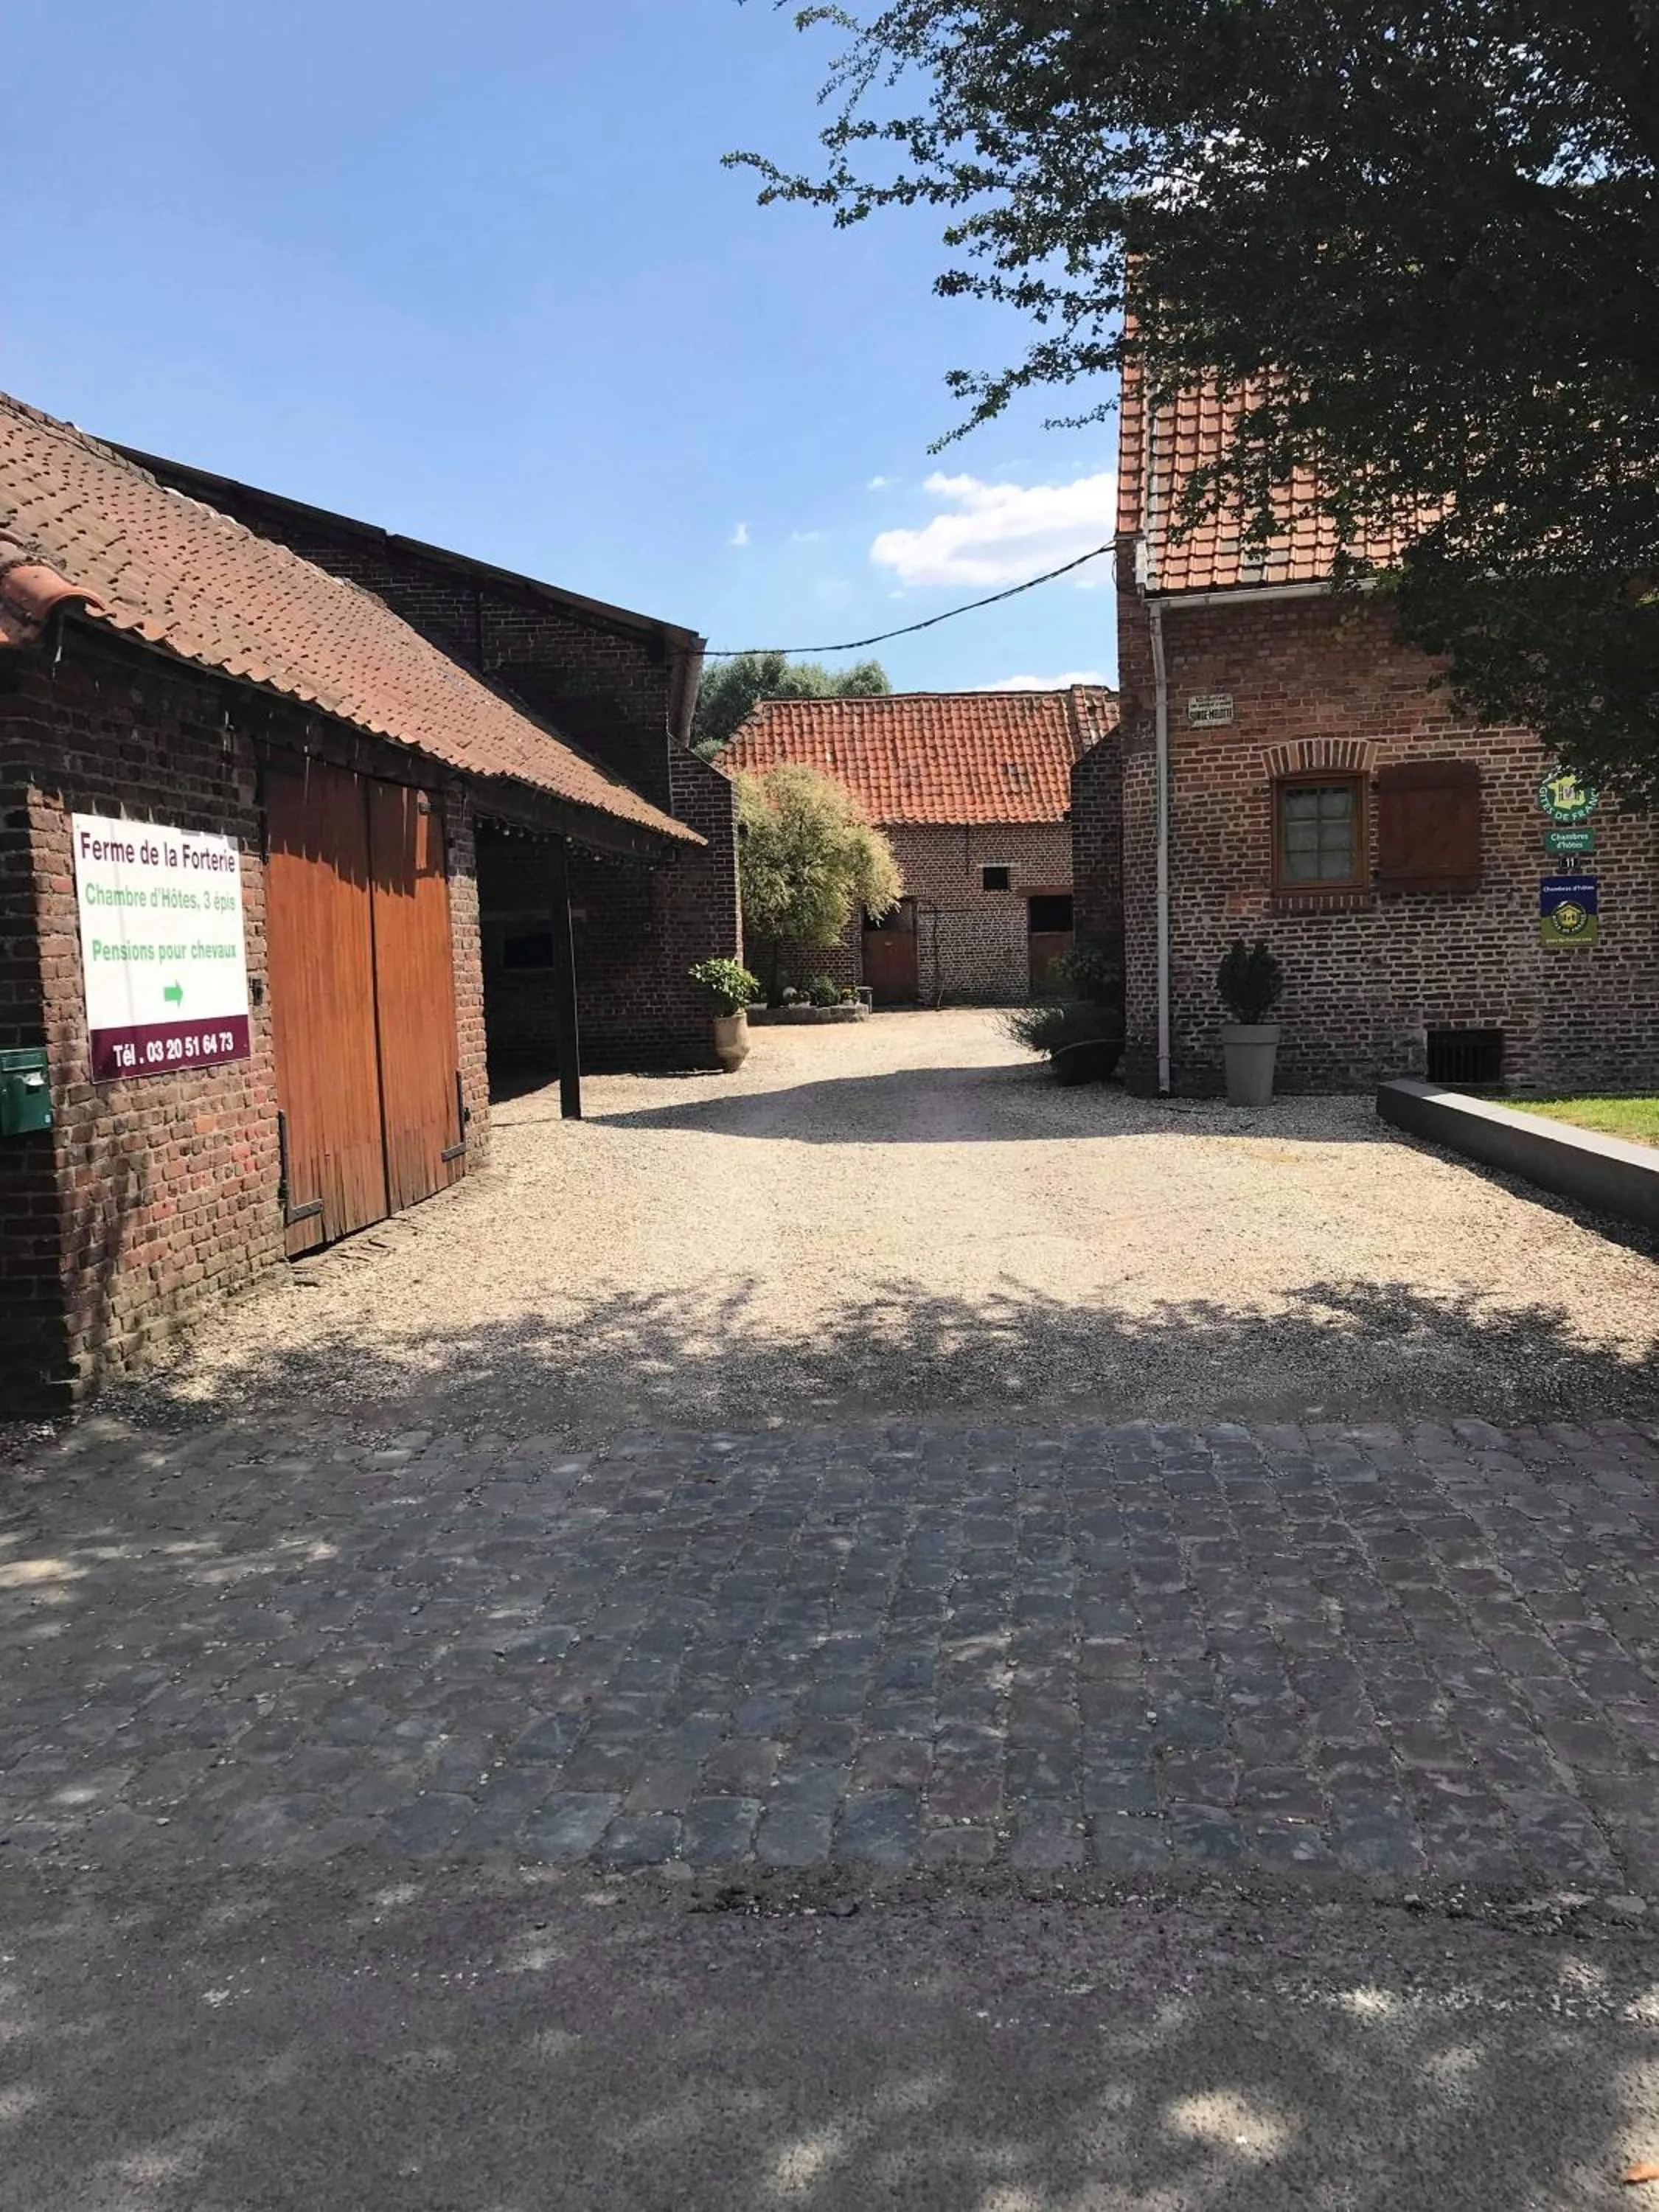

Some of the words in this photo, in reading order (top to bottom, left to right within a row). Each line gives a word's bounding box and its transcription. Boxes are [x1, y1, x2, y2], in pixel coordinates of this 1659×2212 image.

[1571, 787, 1599, 821] FRANC
[80, 832, 135, 863] Ferme
[140, 839, 159, 866] de
[164, 841, 178, 868] la
[182, 844, 235, 873] Forterie
[1565, 858, 1574, 868] 11
[85, 883, 147, 906] Chambre
[150, 887, 201, 912] d'Hôtes,
[204, 891, 211, 910] 3
[214, 891, 236, 914] épis
[91, 939, 155, 961] Pensions
[159, 944, 187, 964] pour
[191, 939, 237, 959] chevaux
[147, 1040, 164, 1062] 03
[167, 1038, 182, 1060] 20
[185, 1036, 200, 1057] 51
[203, 1034, 218, 1054] 64
[220, 1032, 234, 1051] 73
